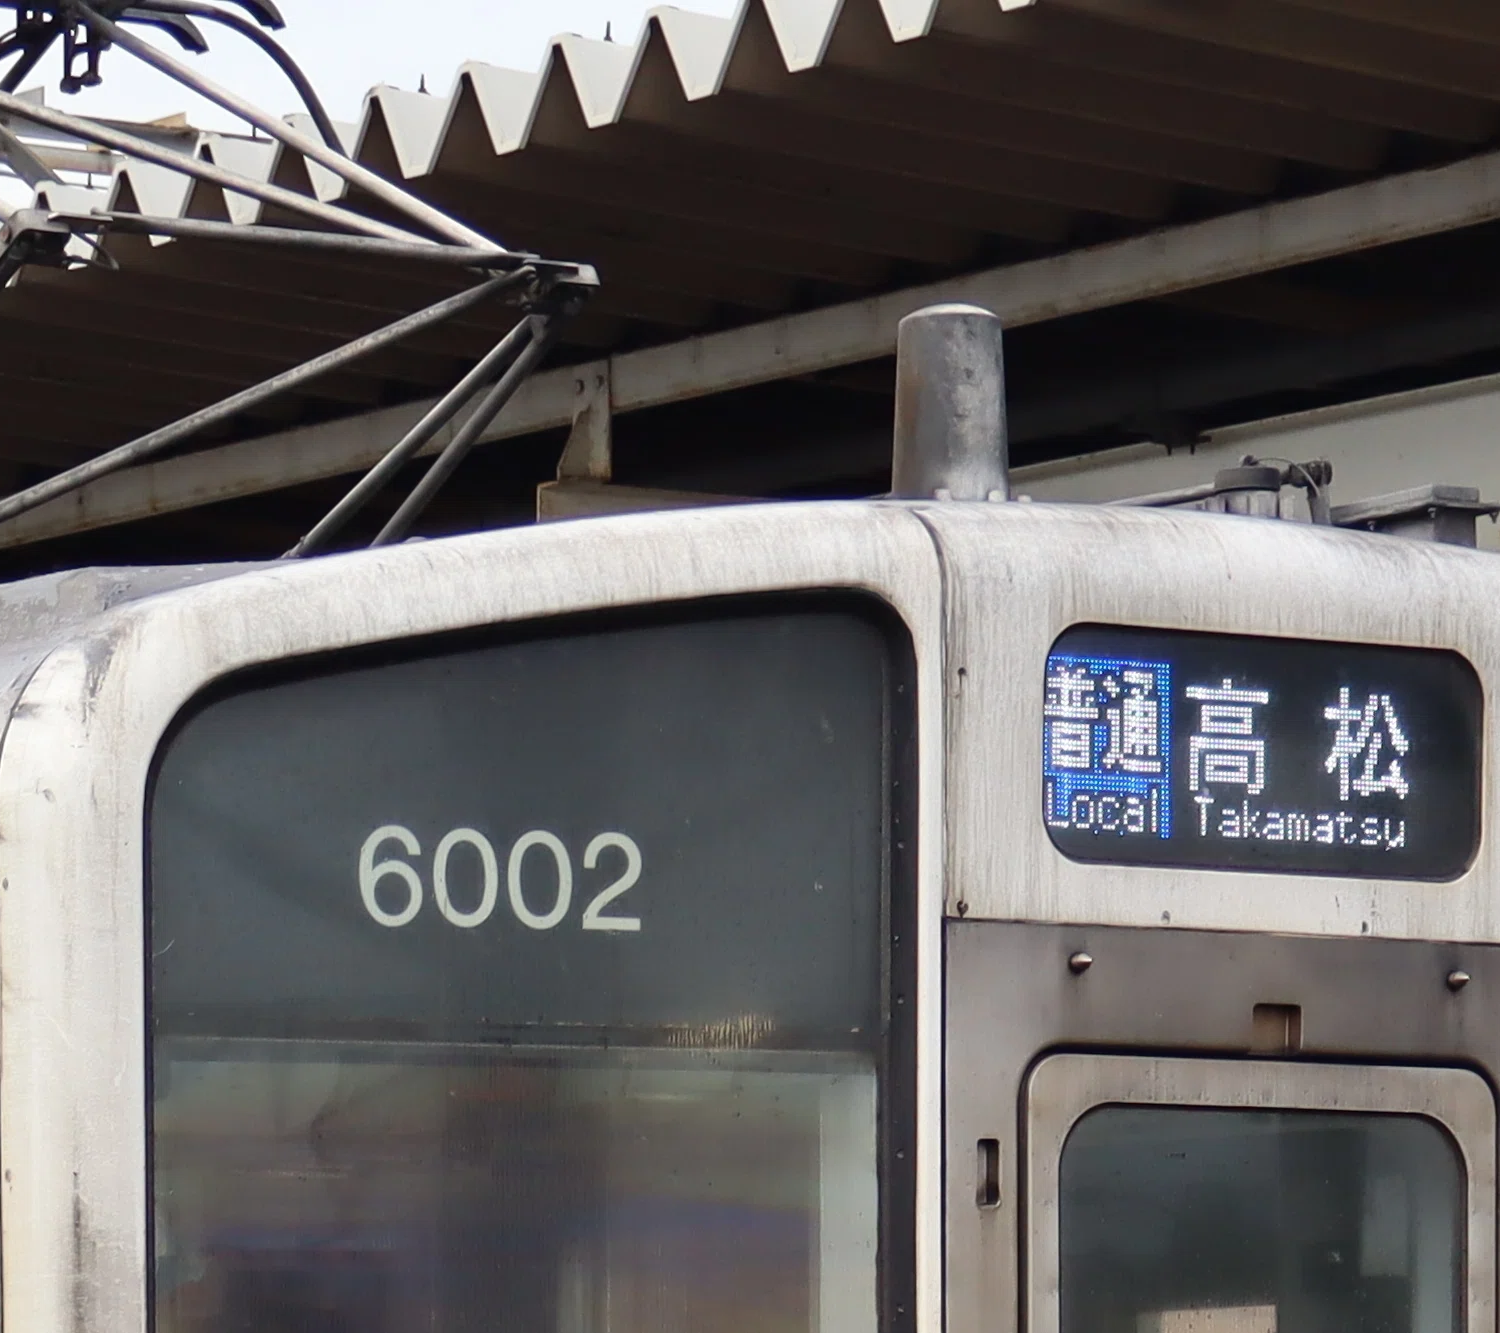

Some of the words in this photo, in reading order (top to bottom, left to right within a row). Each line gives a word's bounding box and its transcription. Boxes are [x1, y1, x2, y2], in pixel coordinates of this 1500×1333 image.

[1044, 666, 1161, 773] 普通
[1186, 677, 1409, 801] 高松
[1046, 782, 1158, 833] Local
[1194, 794, 1406, 851] Takamatsu
[358, 825, 642, 931] 6002
